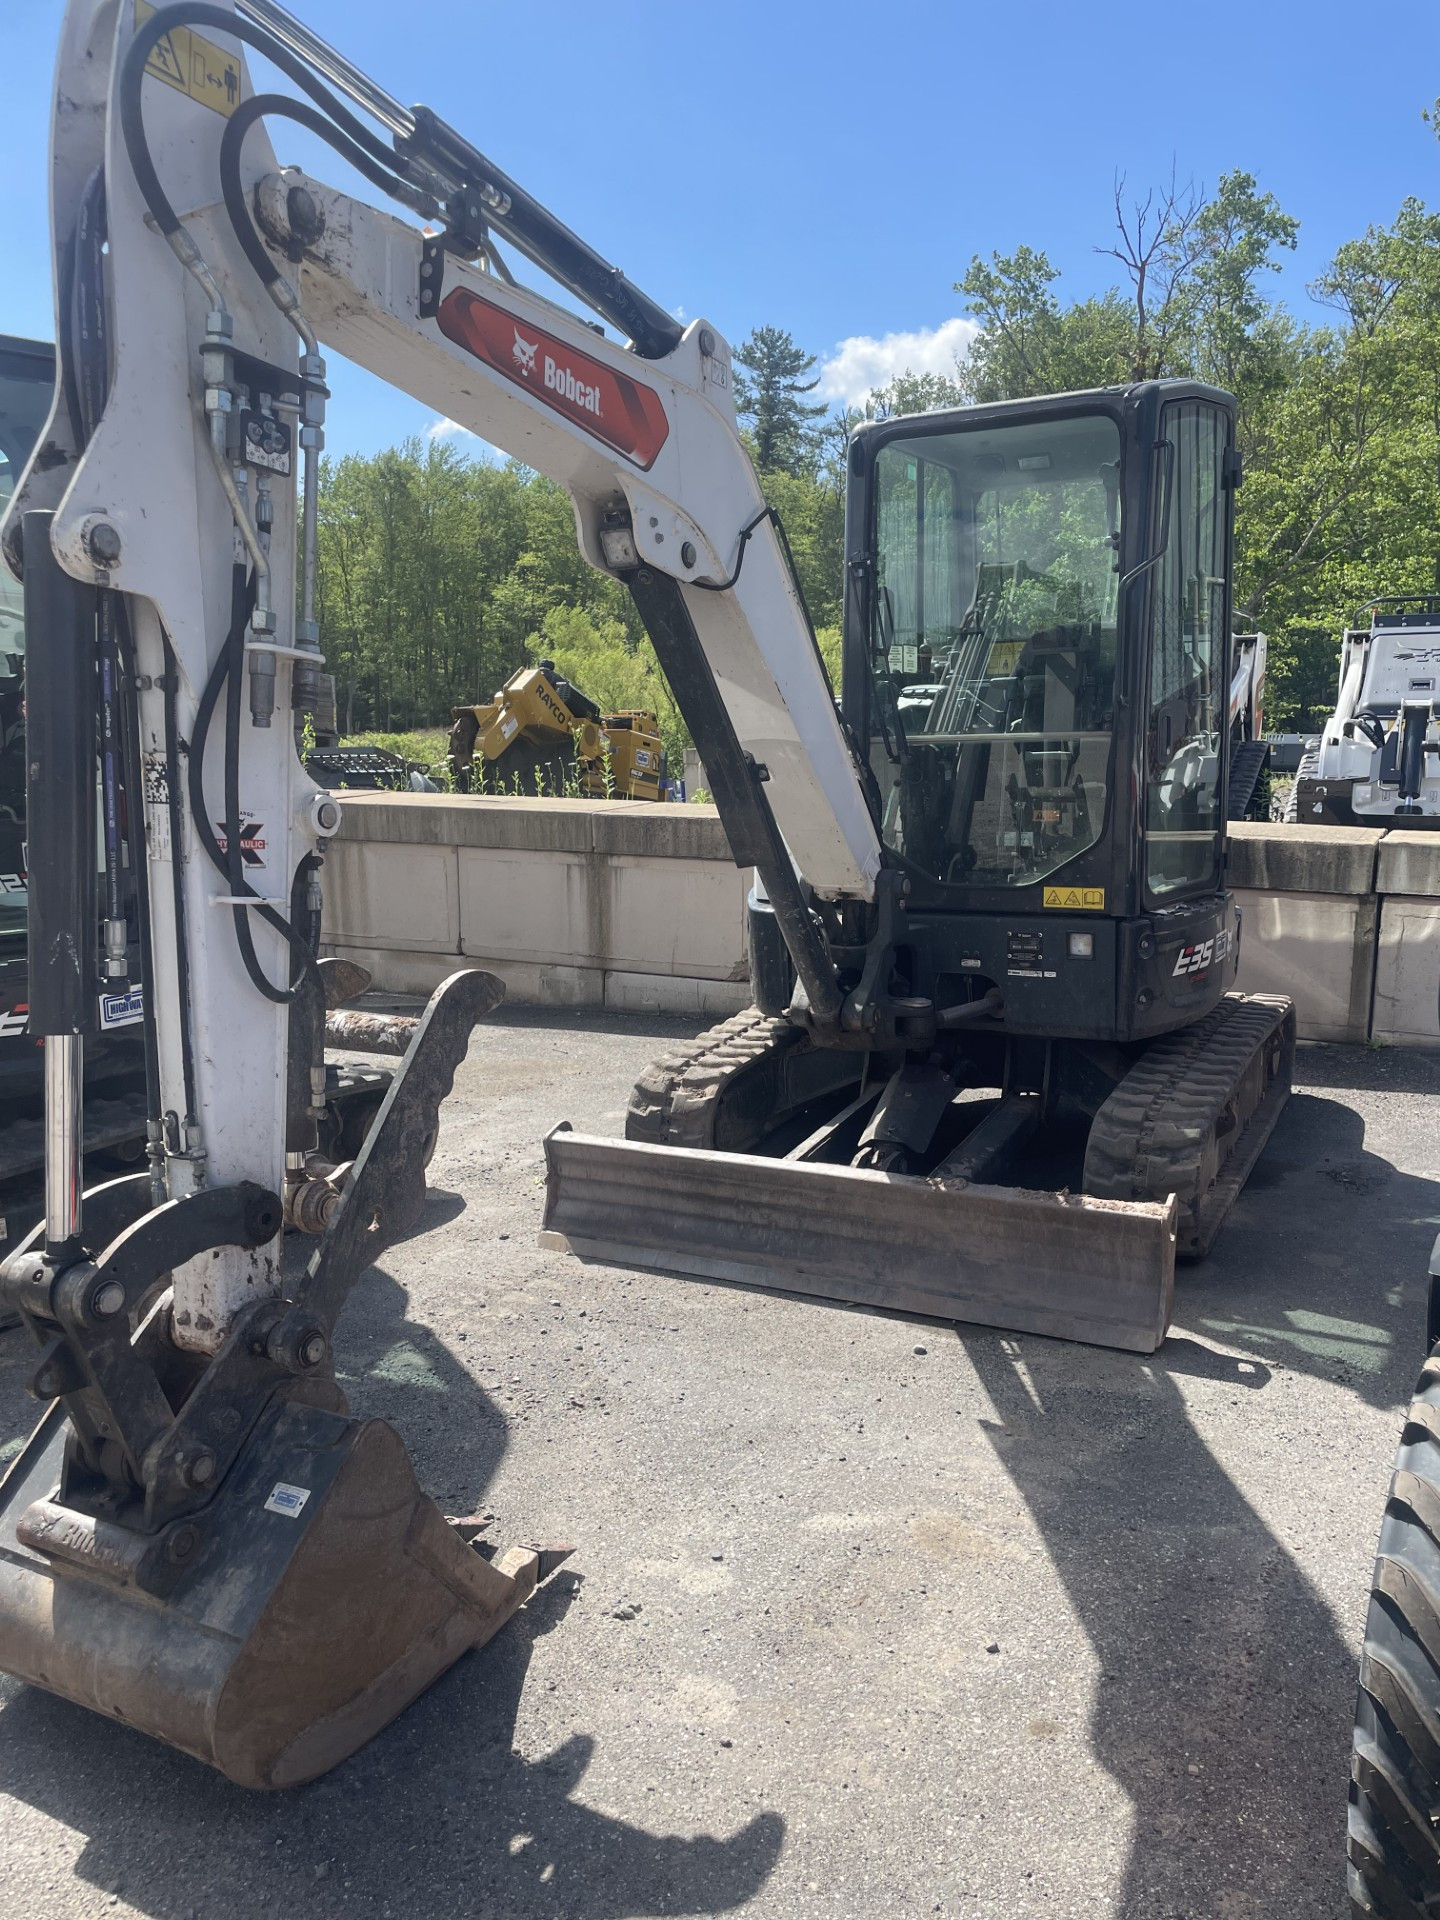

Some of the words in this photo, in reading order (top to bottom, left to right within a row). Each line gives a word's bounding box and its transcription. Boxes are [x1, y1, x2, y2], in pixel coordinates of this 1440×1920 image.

[544, 355, 602, 416] Bobcat
[535, 684, 566, 724] RAYCO
[217, 840, 264, 848] HYAULIC
[1172, 939, 1214, 976] E35
